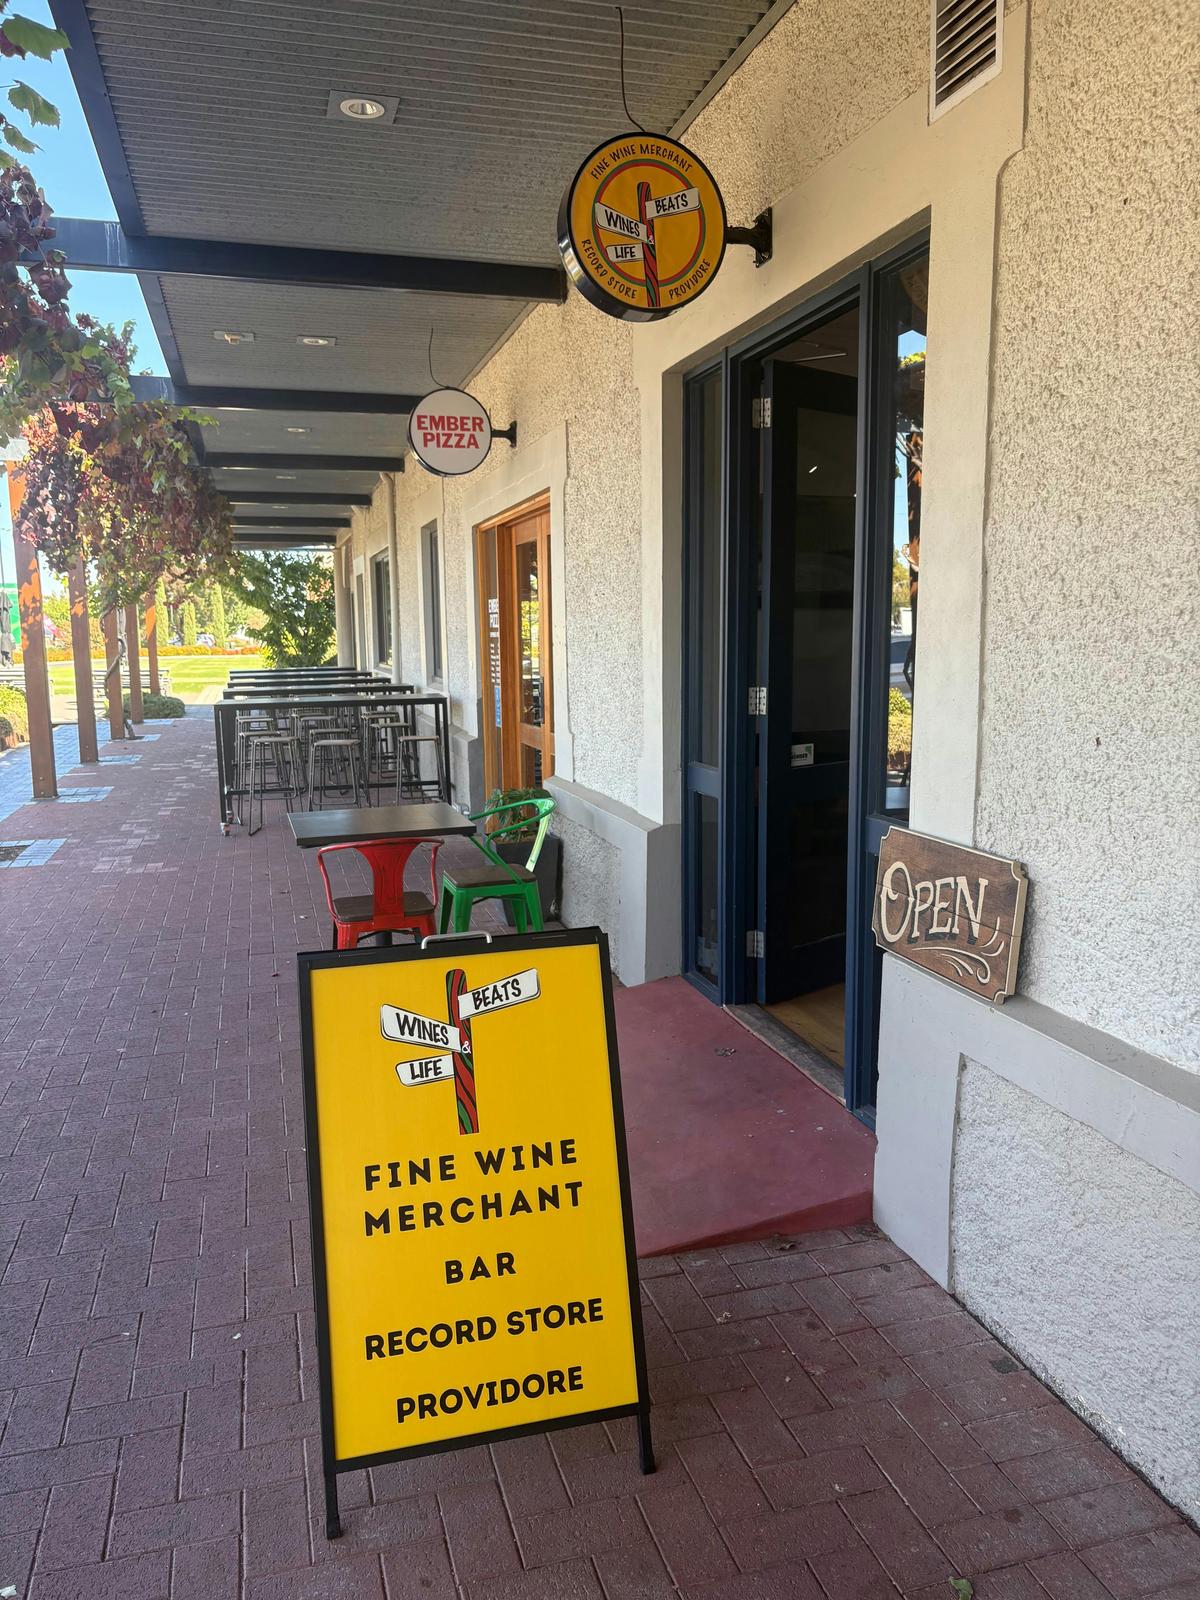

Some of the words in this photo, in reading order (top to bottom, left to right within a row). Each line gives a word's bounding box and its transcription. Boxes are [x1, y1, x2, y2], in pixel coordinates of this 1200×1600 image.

[590, 158, 610, 180] FINE
[609, 144, 637, 163] WINE
[639, 143, 693, 173] MERCHANT
[654, 193, 689, 214] BEATS
[604, 209, 640, 237] WINES
[581, 238, 608, 279] RECORD
[607, 276, 638, 299] STORE
[614, 245, 636, 259] LIFE
[668, 258, 711, 299] PROVIDORE
[416, 414, 484, 432] EMBER
[423, 432, 480, 449] PIZZA
[880, 861, 989, 943] OPEN
[471, 978, 522, 1010] BEATS
[395, 1012, 449, 1046] WINES
[461, 1040, 472, 1054] &
[409, 1058, 443, 1080] LIFE
[364, 1154, 457, 1192] FINE
[474, 1138, 577, 1176] WINE
[364, 1181, 583, 1237] MERCHANT
[444, 1252, 517, 1285] BAR
[365, 1315, 497, 1361] RECORD
[506, 1297, 604, 1336] STORE
[396, 1366, 584, 1424] PROVIDORE
